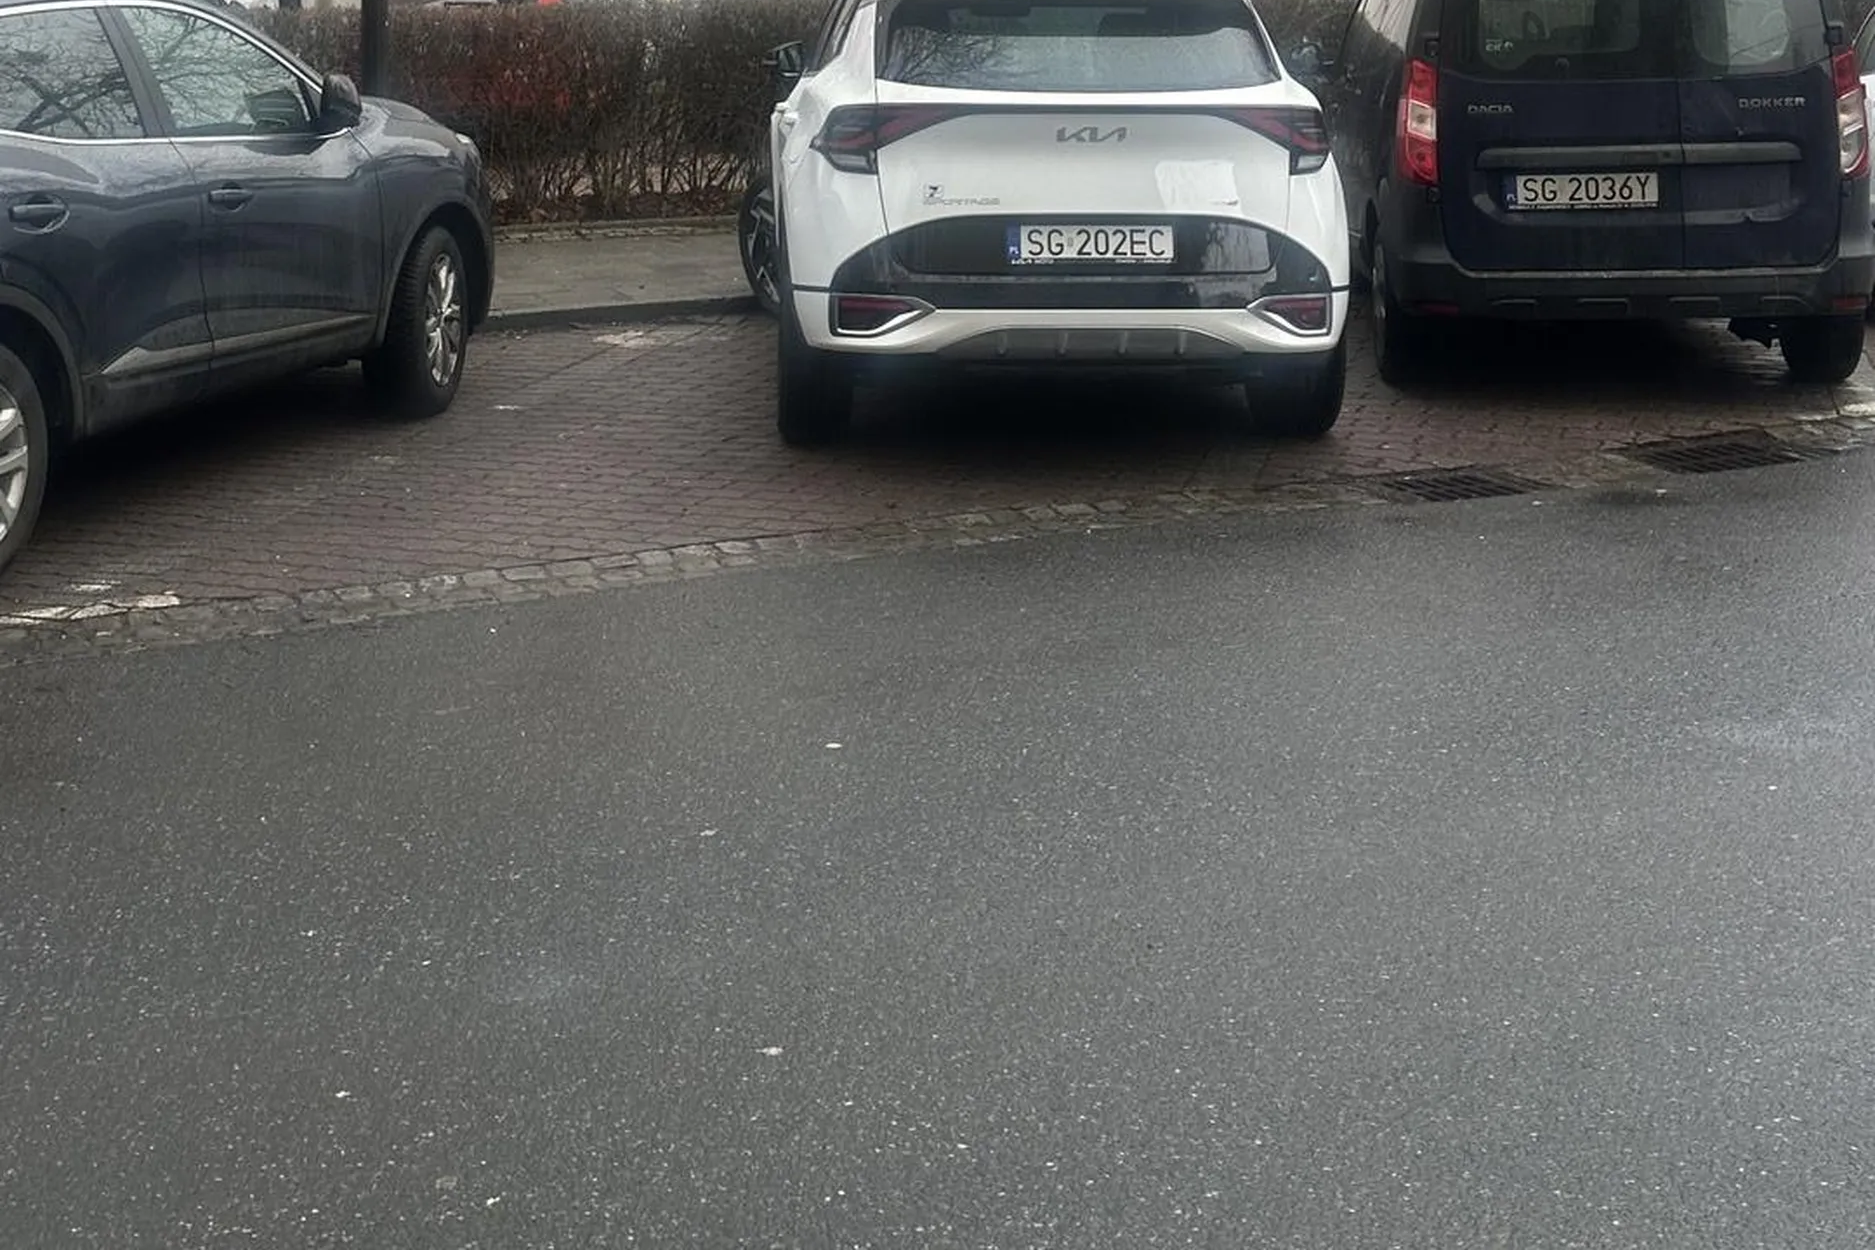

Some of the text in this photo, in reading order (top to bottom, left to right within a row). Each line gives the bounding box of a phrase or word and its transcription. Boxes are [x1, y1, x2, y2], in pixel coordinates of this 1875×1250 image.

[1738, 96, 1807, 109] DOKKER
[1056, 126, 1127, 143] KIA
[1523, 174, 1650, 202] SG 2036Y
[1027, 229, 1166, 257] SG 202EC
